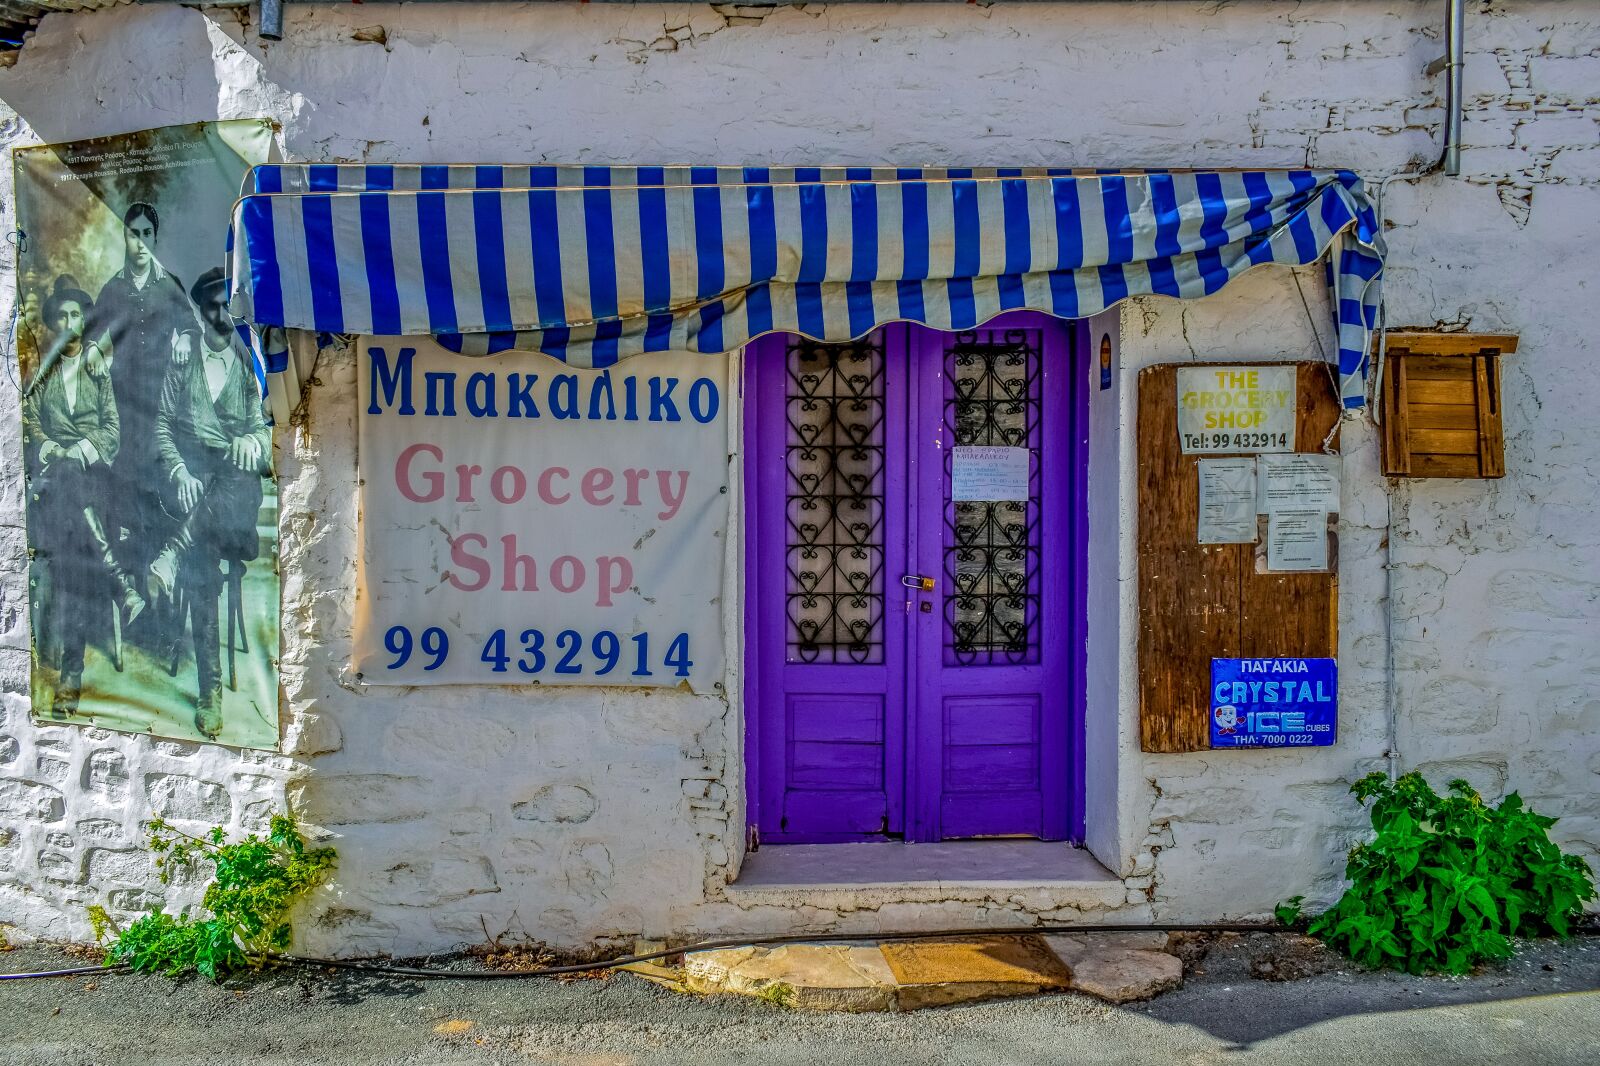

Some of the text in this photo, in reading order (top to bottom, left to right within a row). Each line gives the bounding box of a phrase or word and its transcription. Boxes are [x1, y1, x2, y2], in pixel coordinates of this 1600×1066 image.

[68, 156, 80, 164] 1917
[60, 174, 72, 182] 1917
[1215, 371, 1259, 389] THE
[1183, 390, 1290, 410] GROCERY
[1204, 411, 1268, 429] SHOP
[1184, 432, 1287, 449] Tel: 99 432914
[395, 442, 690, 521] Grocery
[449, 532, 634, 607] Shop
[384, 625, 694, 677] 99 432914
[1215, 681, 1331, 704] CRYSTAL
[1246, 711, 1330, 732] ICE CUBES
[1262, 735, 1286, 744] 7000
[1289, 735, 1313, 744] 0222
